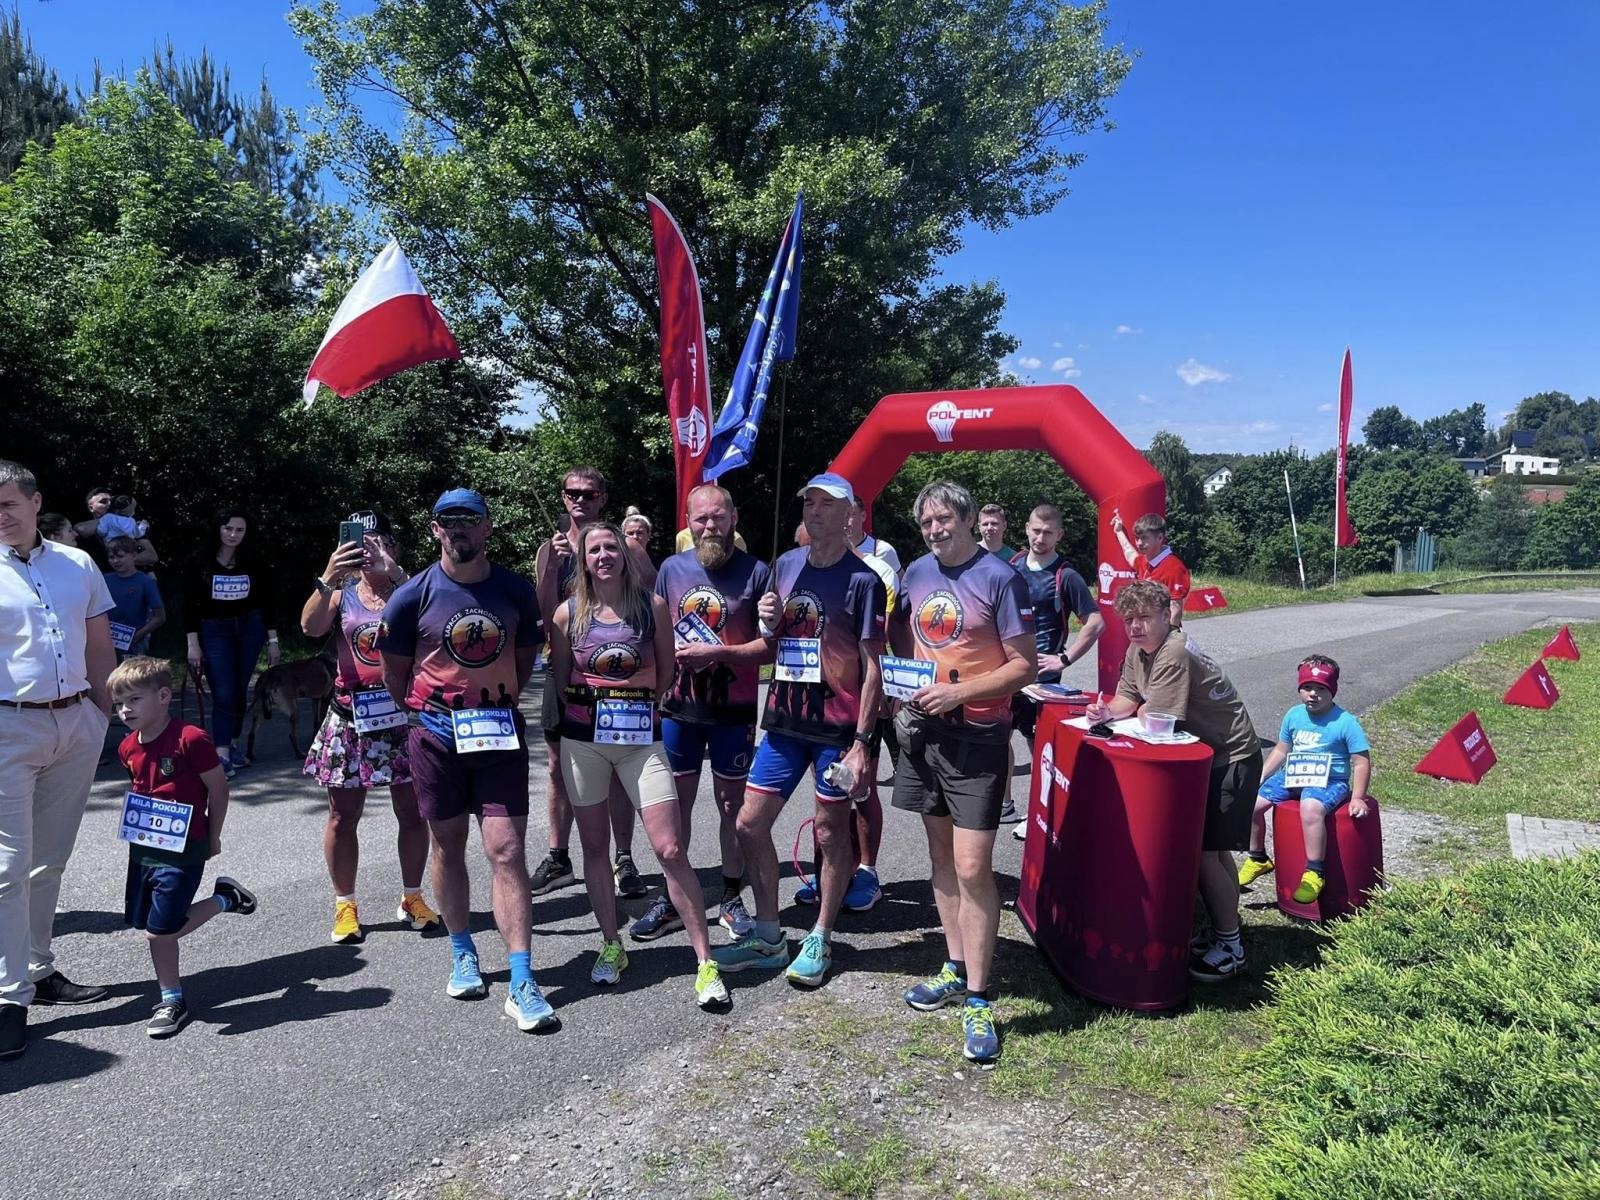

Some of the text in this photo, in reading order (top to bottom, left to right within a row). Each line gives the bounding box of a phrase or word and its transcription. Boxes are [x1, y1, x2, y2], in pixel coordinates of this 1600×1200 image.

[929, 408, 993, 420] POLTENT
[702, 628, 718, 645] POKO
[883, 657, 931, 669] MILA POKOJU
[457, 710, 508, 719] MILA POKOJU
[1295, 730, 1322, 742] NIKE
[131, 797, 151, 809] MILA
[152, 802, 188, 815] POKOJU
[149, 817, 163, 828] 10
